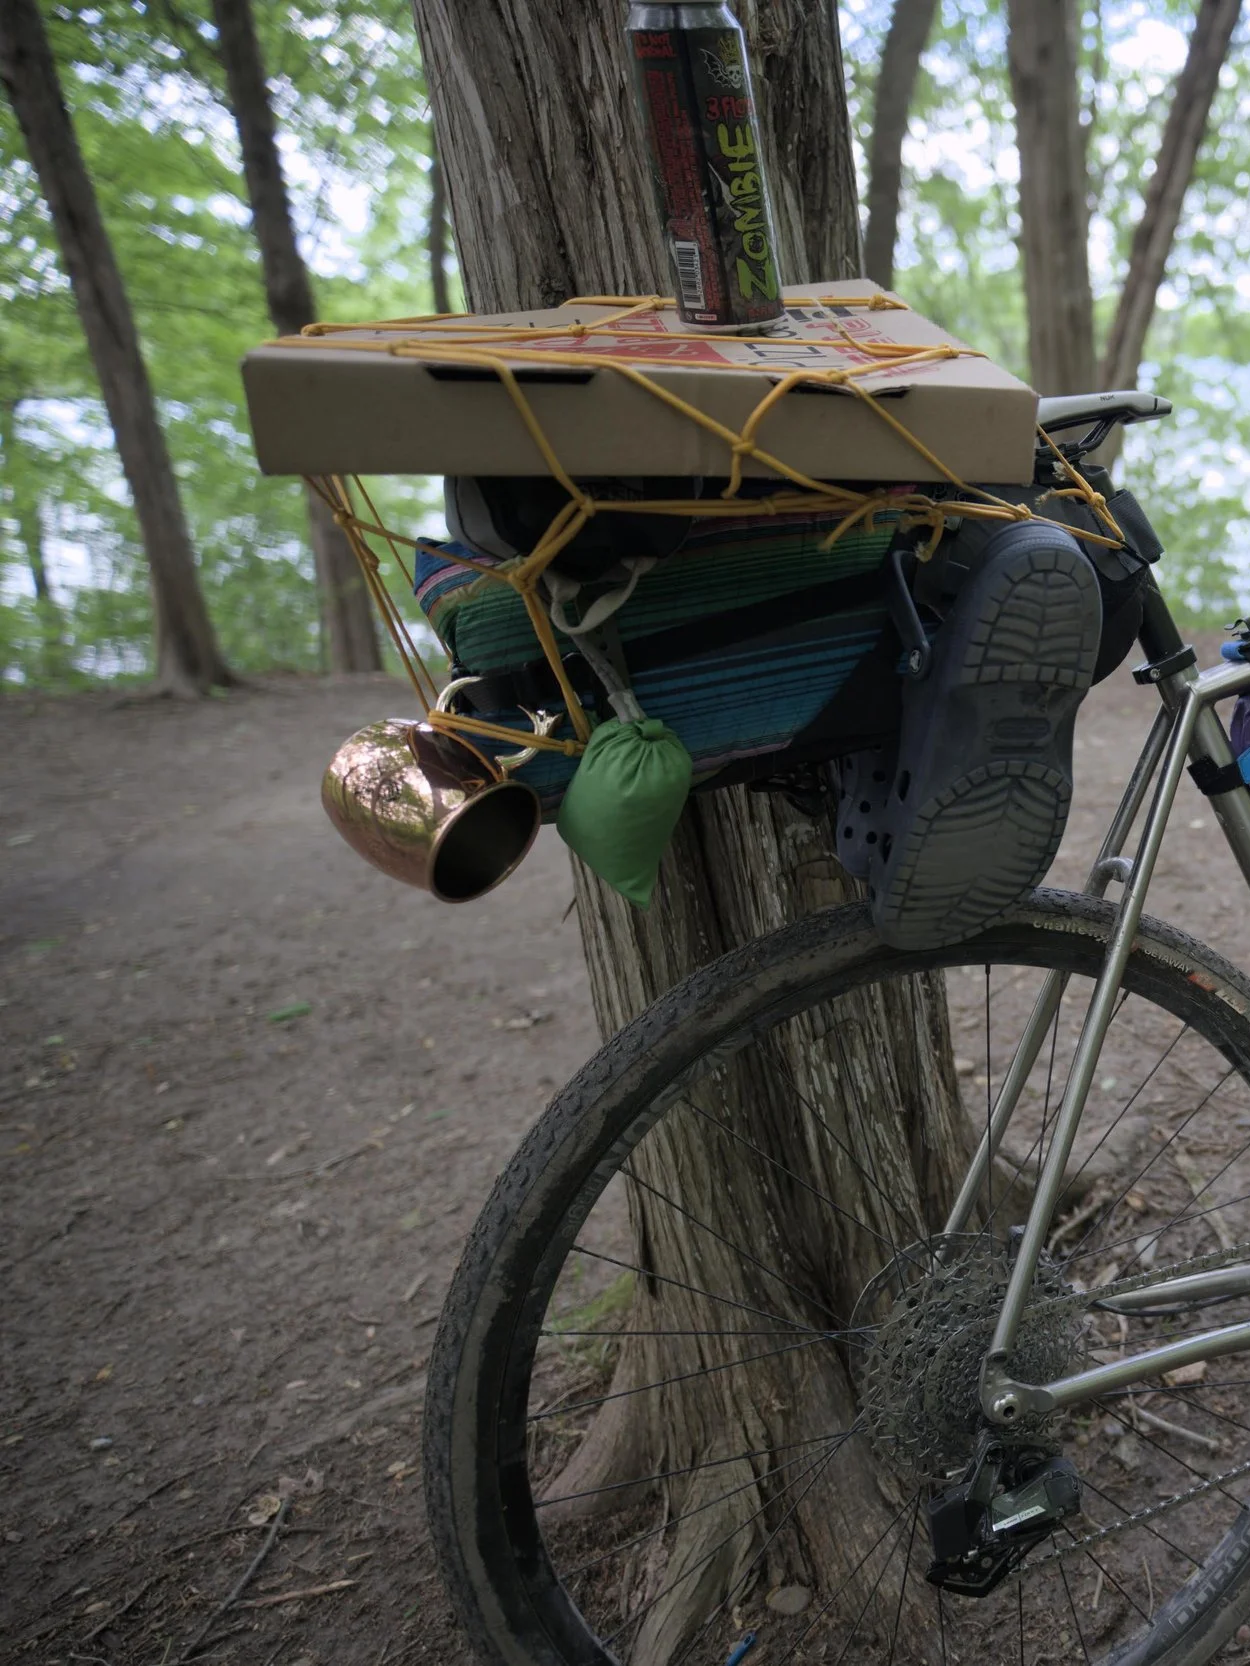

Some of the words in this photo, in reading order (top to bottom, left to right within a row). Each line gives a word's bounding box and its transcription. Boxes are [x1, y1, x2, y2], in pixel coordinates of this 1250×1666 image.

[706, 96, 720, 120] 3
[717, 123, 777, 300] ZOMBIE
[1144, 949, 1192, 973] GETAWAY
